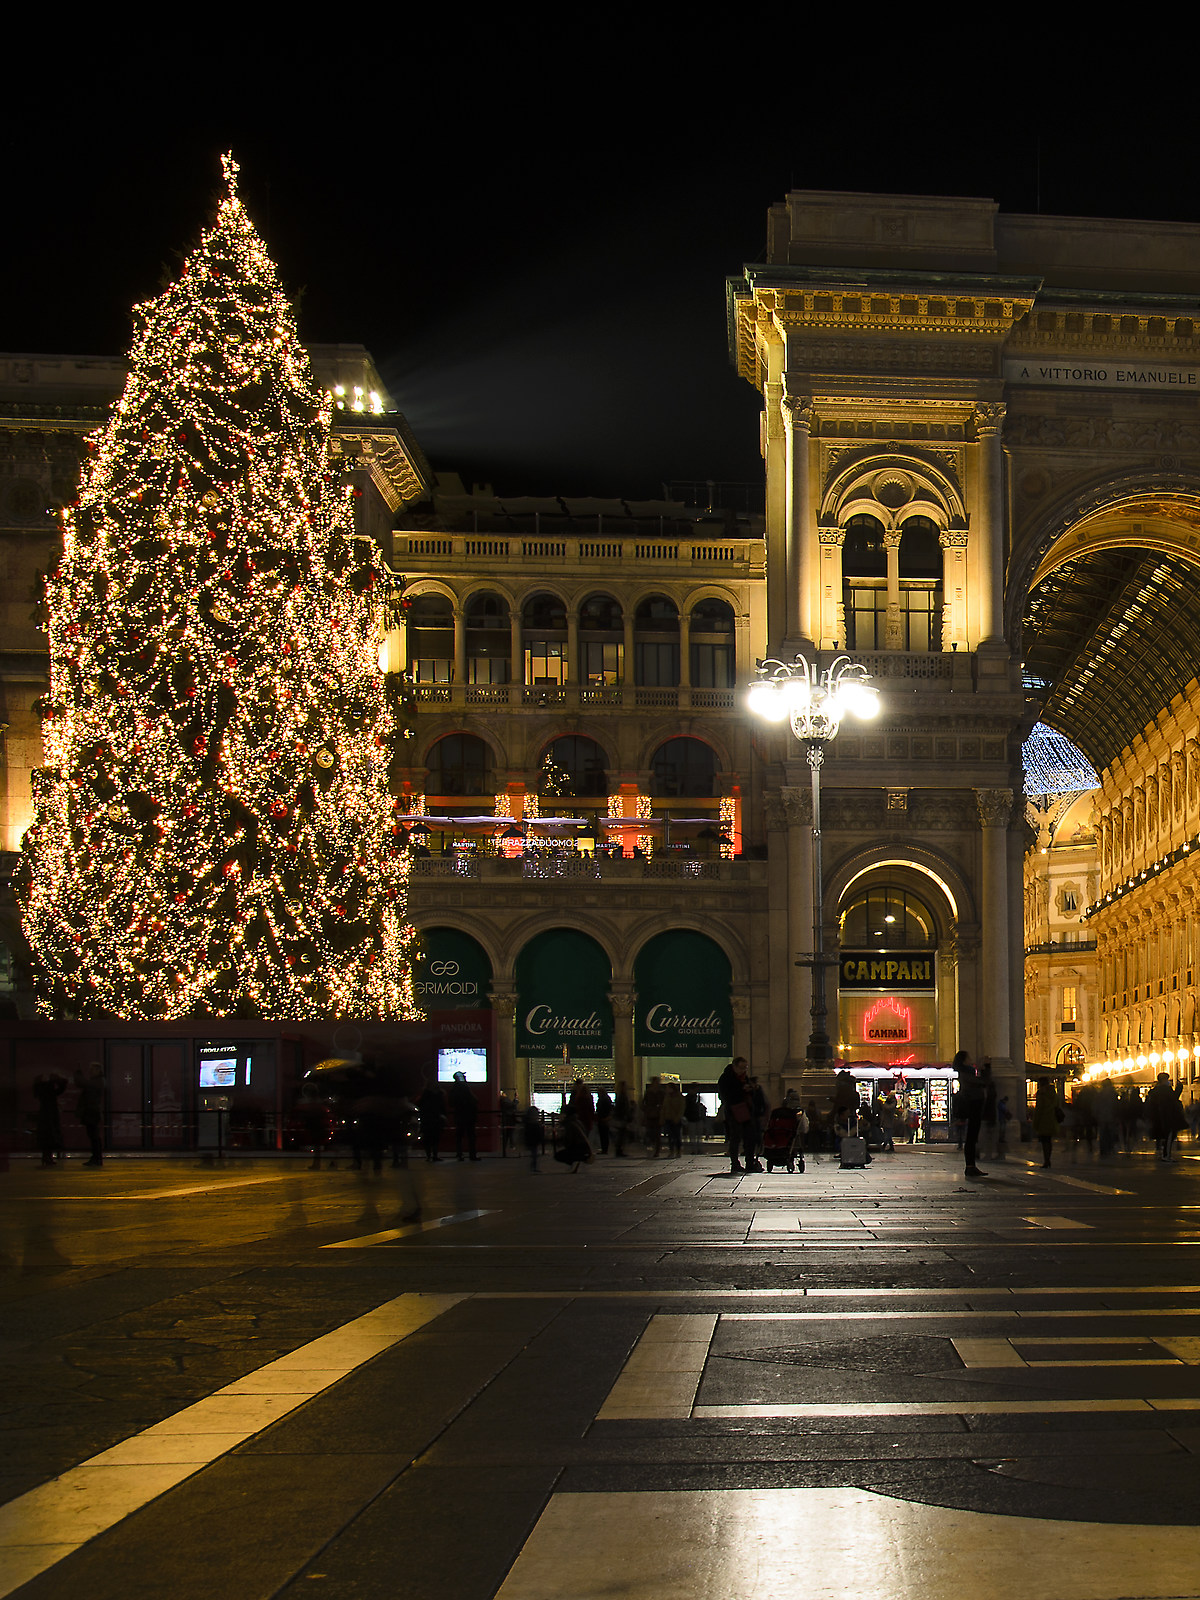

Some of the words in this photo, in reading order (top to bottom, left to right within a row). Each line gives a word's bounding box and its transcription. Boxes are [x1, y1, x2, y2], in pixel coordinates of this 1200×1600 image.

[1020, 368, 1030, 378] A
[1039, 367, 1107, 381] VITTORIO
[1116, 370, 1197, 385] EMANUELE
[539, 839, 573, 847] DUOMO
[843, 961, 930, 980] CAMPARI
[414, 982, 478, 994] GRIMOLDI
[525, 1004, 601, 1035] Currado
[645, 1003, 722, 1034] Currado
[868, 1029, 907, 1038] CAMPARI
